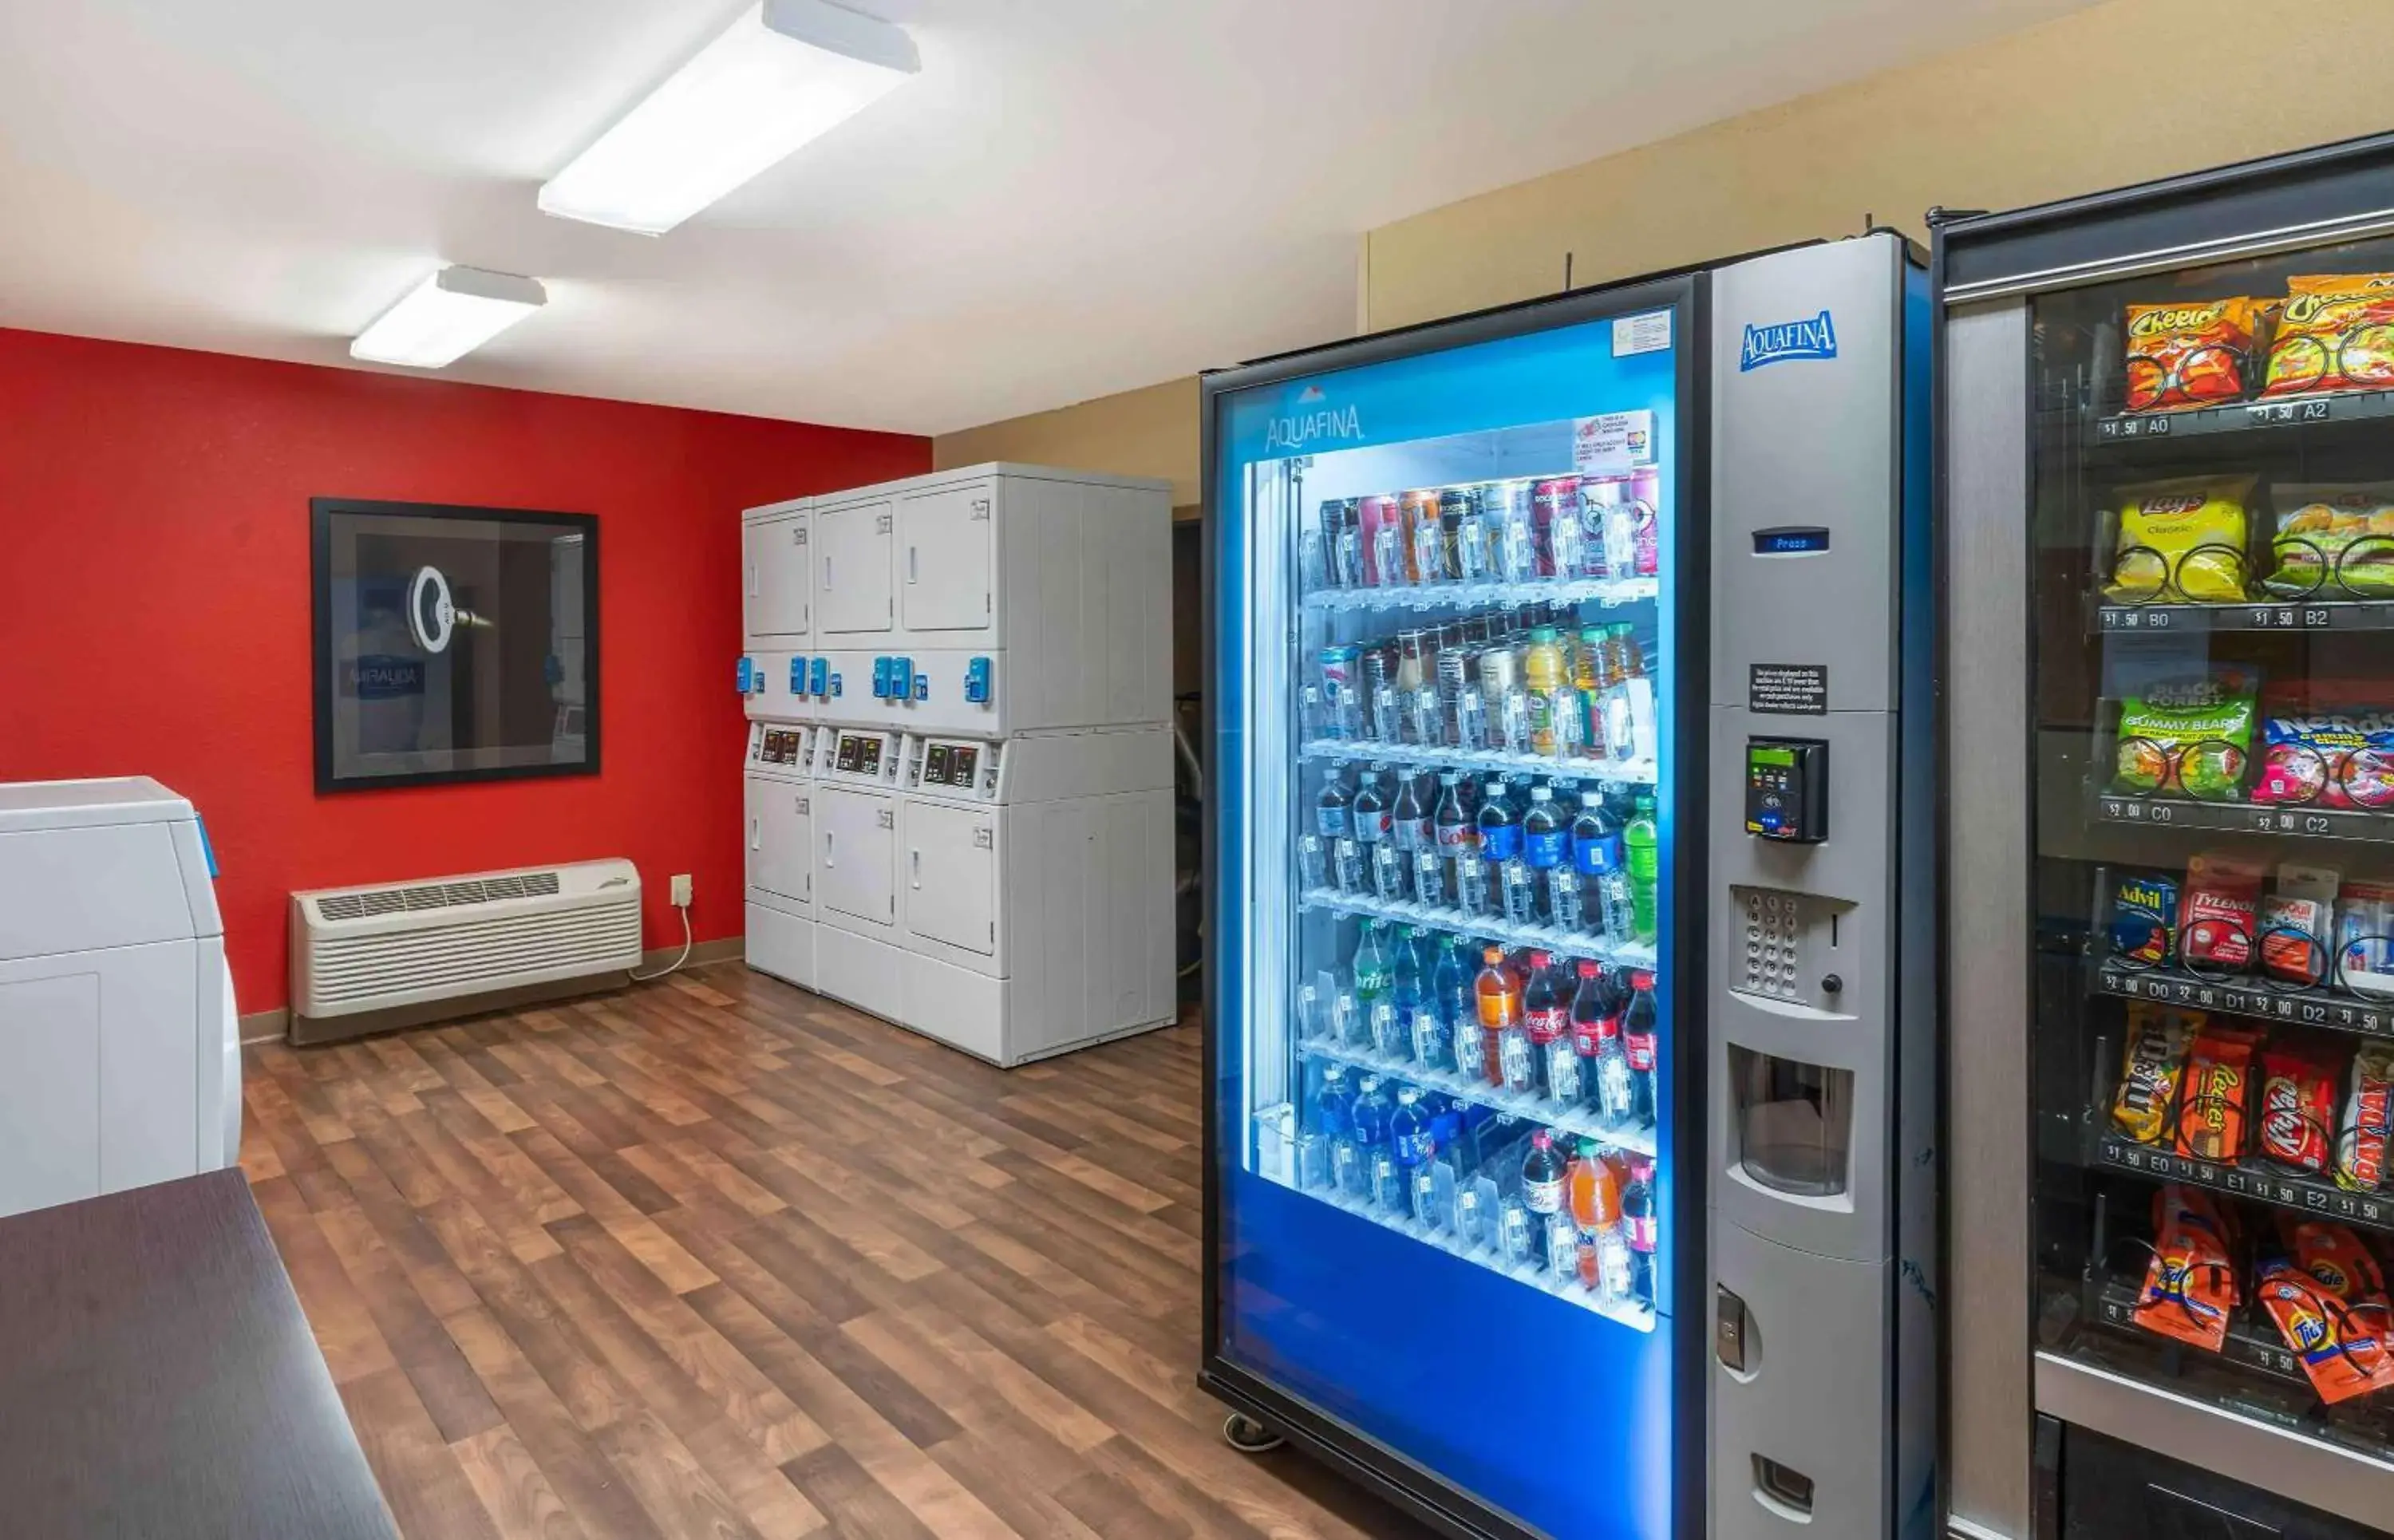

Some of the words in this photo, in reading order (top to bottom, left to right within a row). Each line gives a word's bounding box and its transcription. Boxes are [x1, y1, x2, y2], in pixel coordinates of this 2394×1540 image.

[1744, 314, 1834, 359] AQUAFINA
[2304, 403, 2326, 417] A2
[1265, 404, 1363, 453] AQUAFINA
[2150, 419, 2169, 433] A0
[2150, 614, 2168, 626] B0
[2305, 611, 2328, 626] B2
[2148, 693, 2224, 706] FOREST
[2126, 715, 2189, 729] GUMMY
[2151, 808, 2171, 822] C0
[2305, 819, 2329, 833] C2
[2119, 885, 2160, 910] Advil
[2195, 891, 2256, 912] TYLENOL
[2227, 1174, 2245, 1190] E1
[2307, 1191, 2327, 1209] E2
